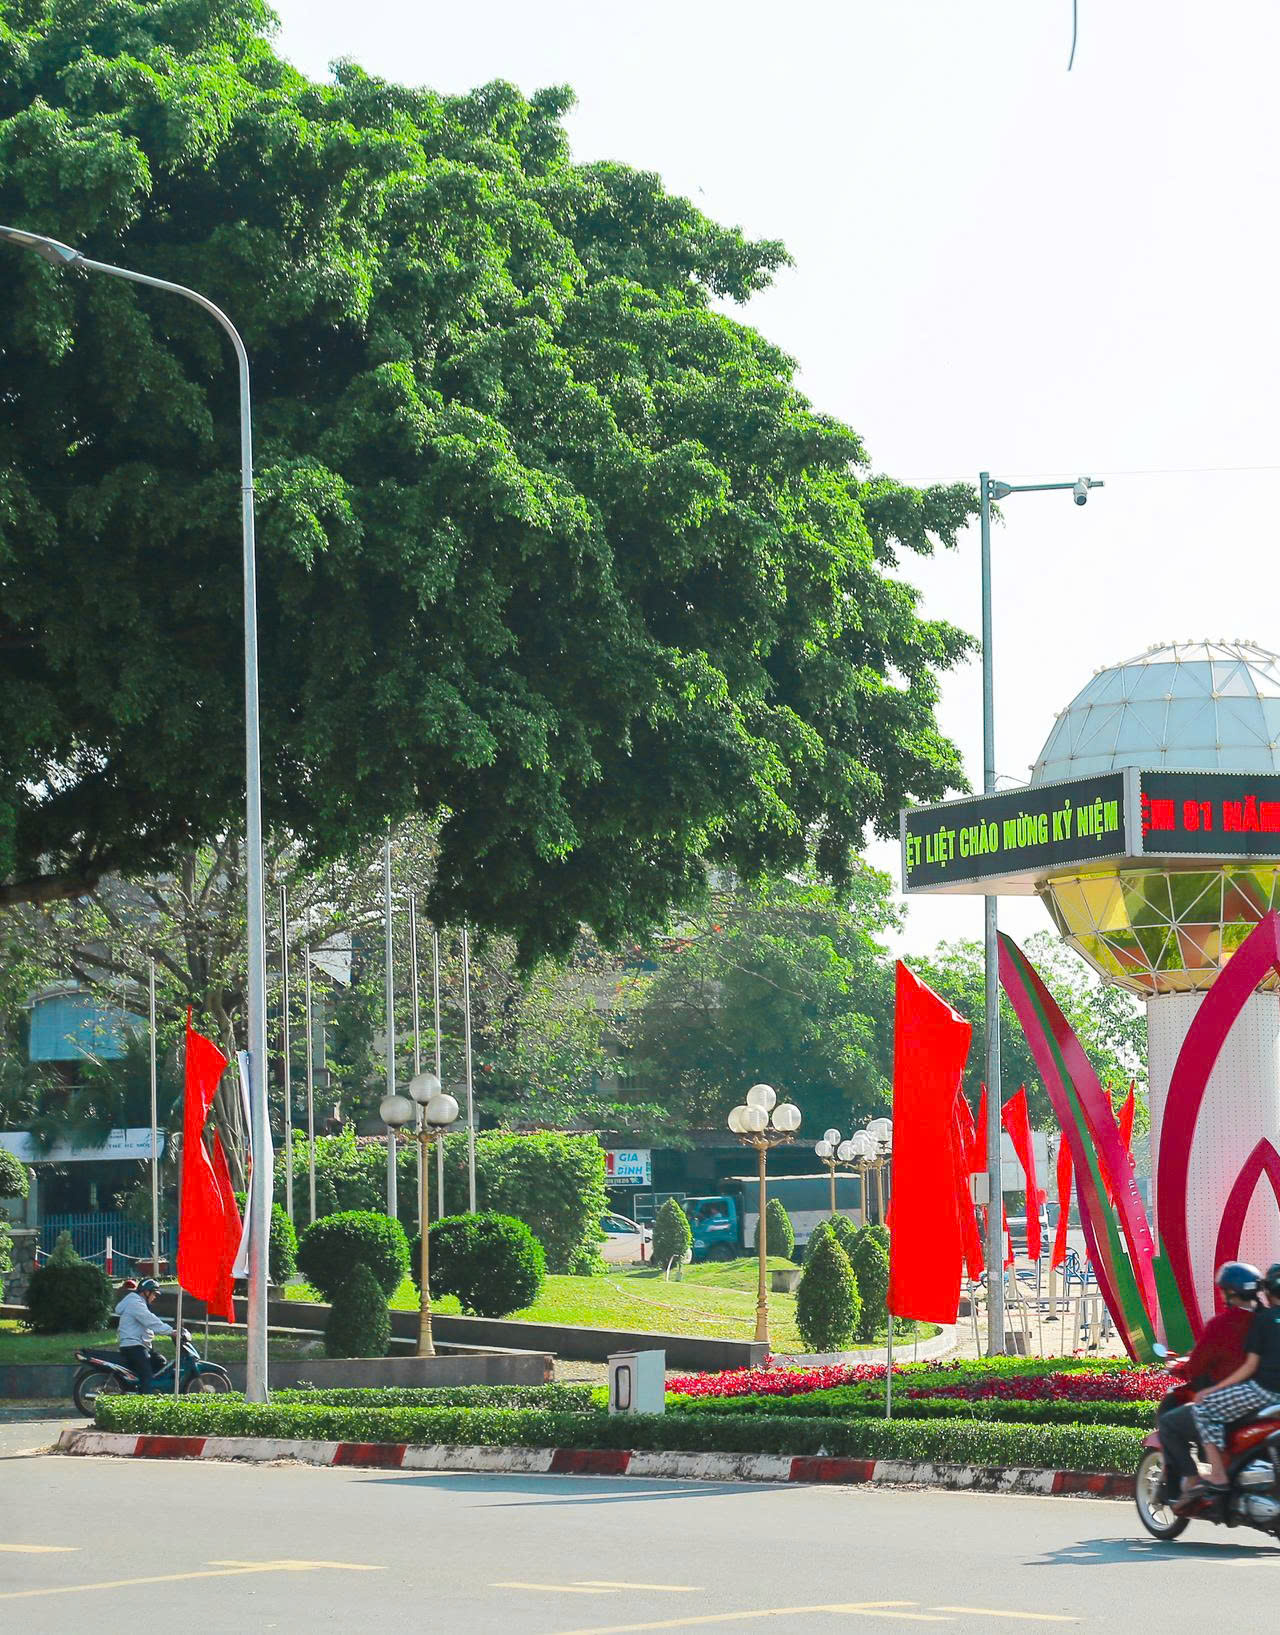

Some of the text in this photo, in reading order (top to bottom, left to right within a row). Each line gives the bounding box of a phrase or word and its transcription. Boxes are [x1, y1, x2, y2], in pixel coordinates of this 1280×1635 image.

[926, 826, 956, 867] LIỆT
[959, 818, 999, 858] CHÀO
[1003, 811, 1048, 850] MỪNG
[1052, 799, 1073, 842] KỶ
[1077, 797, 1119, 841] NIỆM
[619, 1152, 639, 1162] GIA
